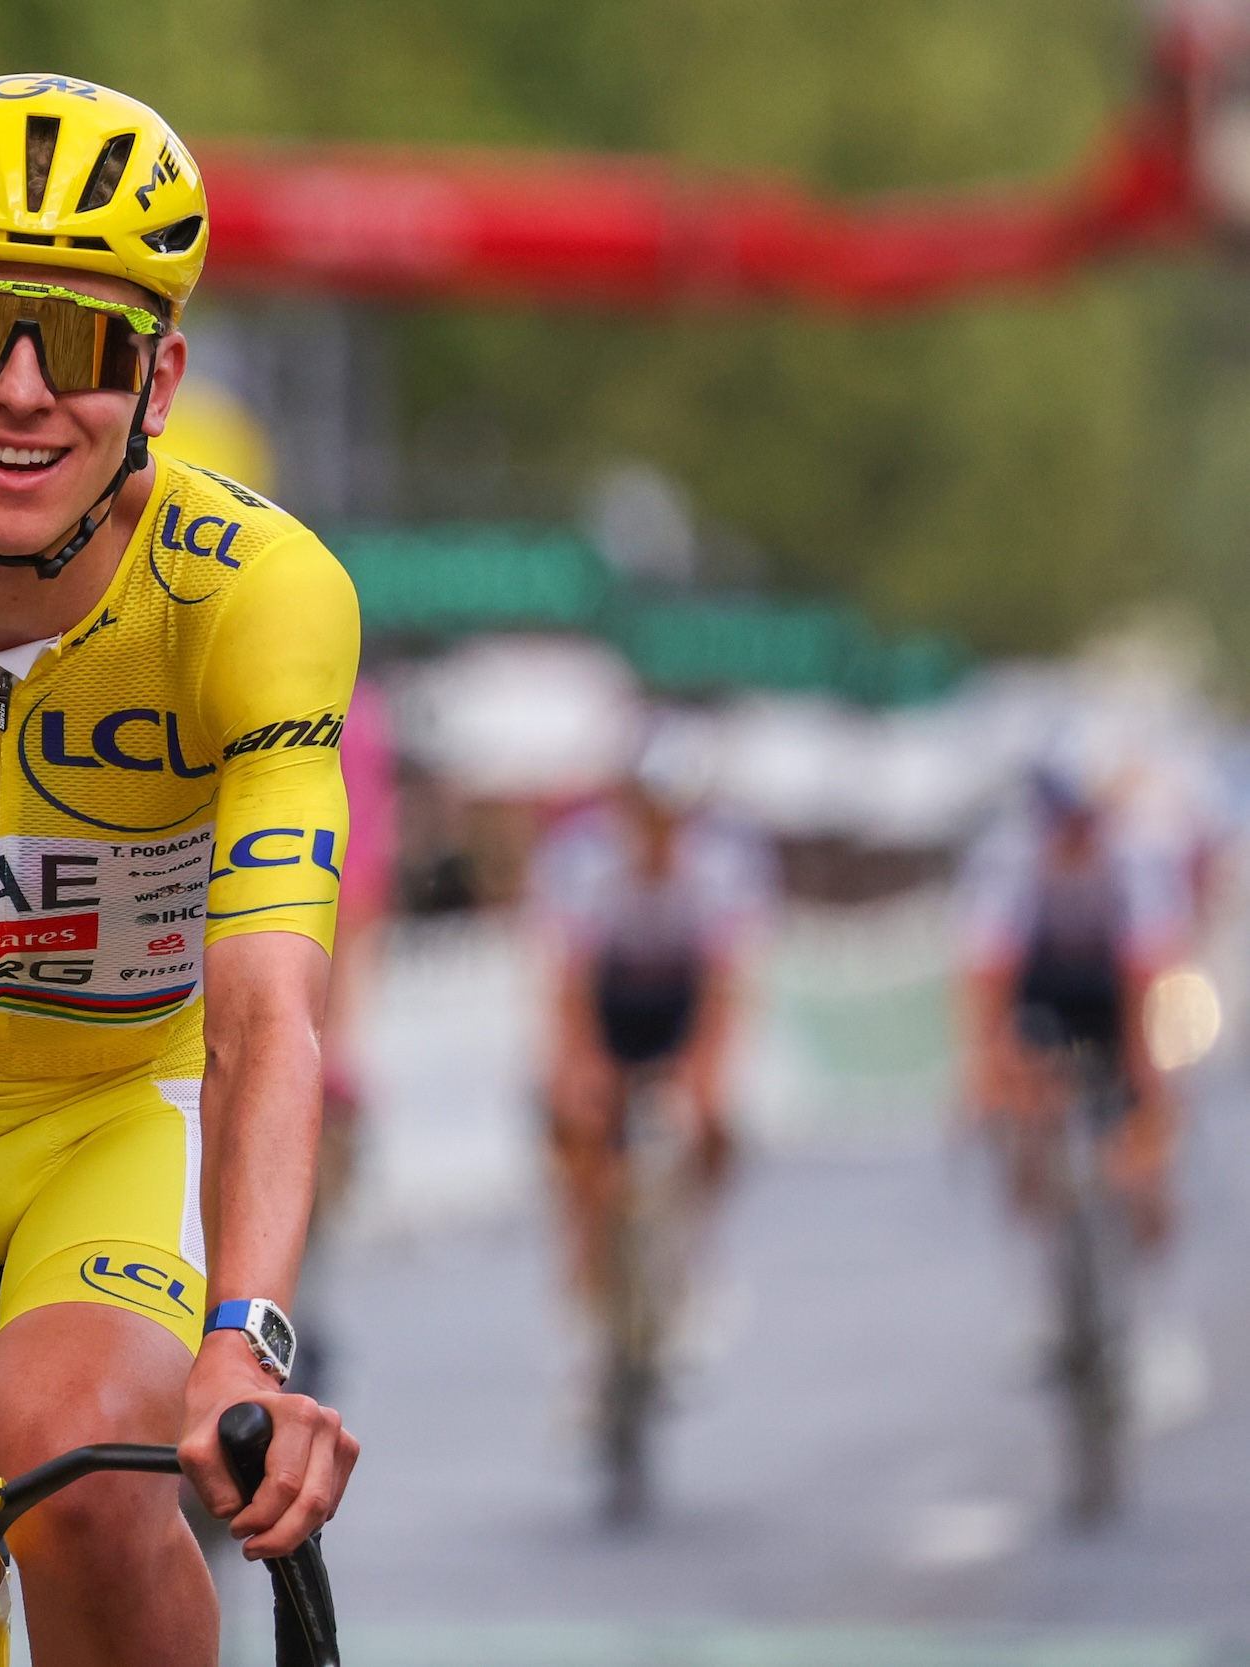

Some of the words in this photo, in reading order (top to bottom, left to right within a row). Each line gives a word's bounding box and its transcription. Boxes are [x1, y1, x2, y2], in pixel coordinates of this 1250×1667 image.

[161, 504, 241, 569] LCL
[42, 708, 216, 778] LCL
[111, 846, 125, 857] T.
[131, 832, 210, 857] POGACAR
[162, 904, 203, 924] IHC
[138, 962, 194, 978] PISSEI
[93, 1256, 194, 1316] LCL
